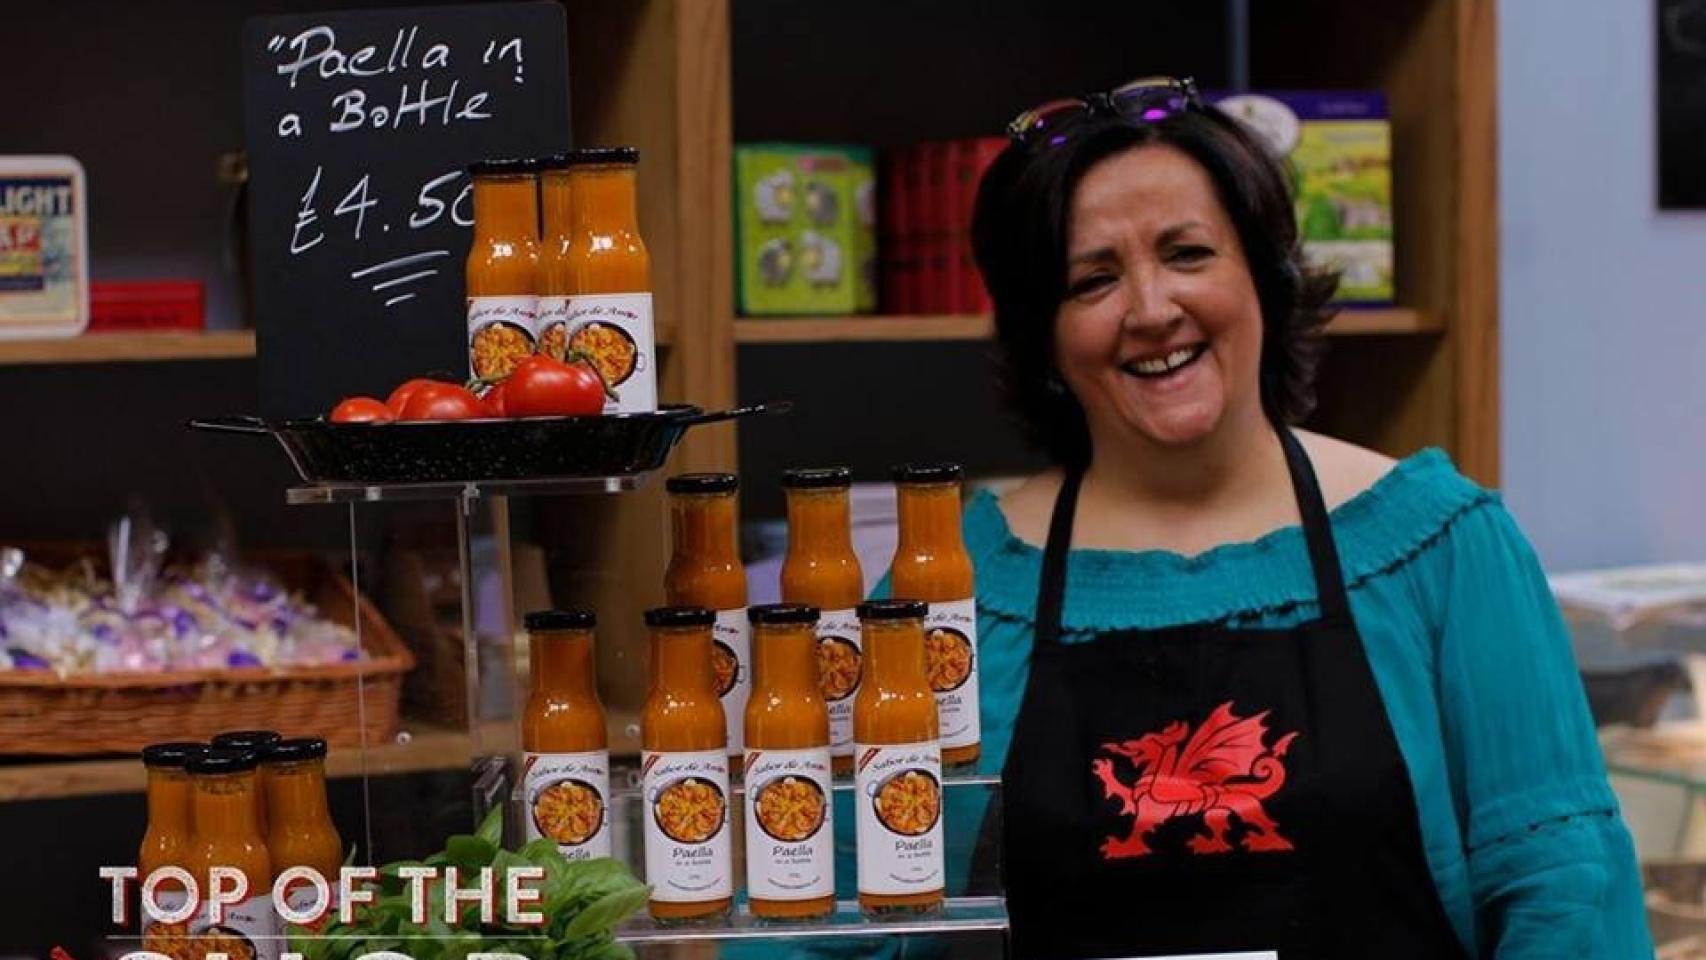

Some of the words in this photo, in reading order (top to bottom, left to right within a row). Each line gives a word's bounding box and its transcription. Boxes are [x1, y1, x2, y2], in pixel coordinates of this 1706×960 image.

[278, 113, 301, 136] a
[330, 79, 492, 131] Bottle
[772, 844, 813, 856] Paella
[895, 837, 933, 852] Paella
[672, 846, 713, 858] Paella
